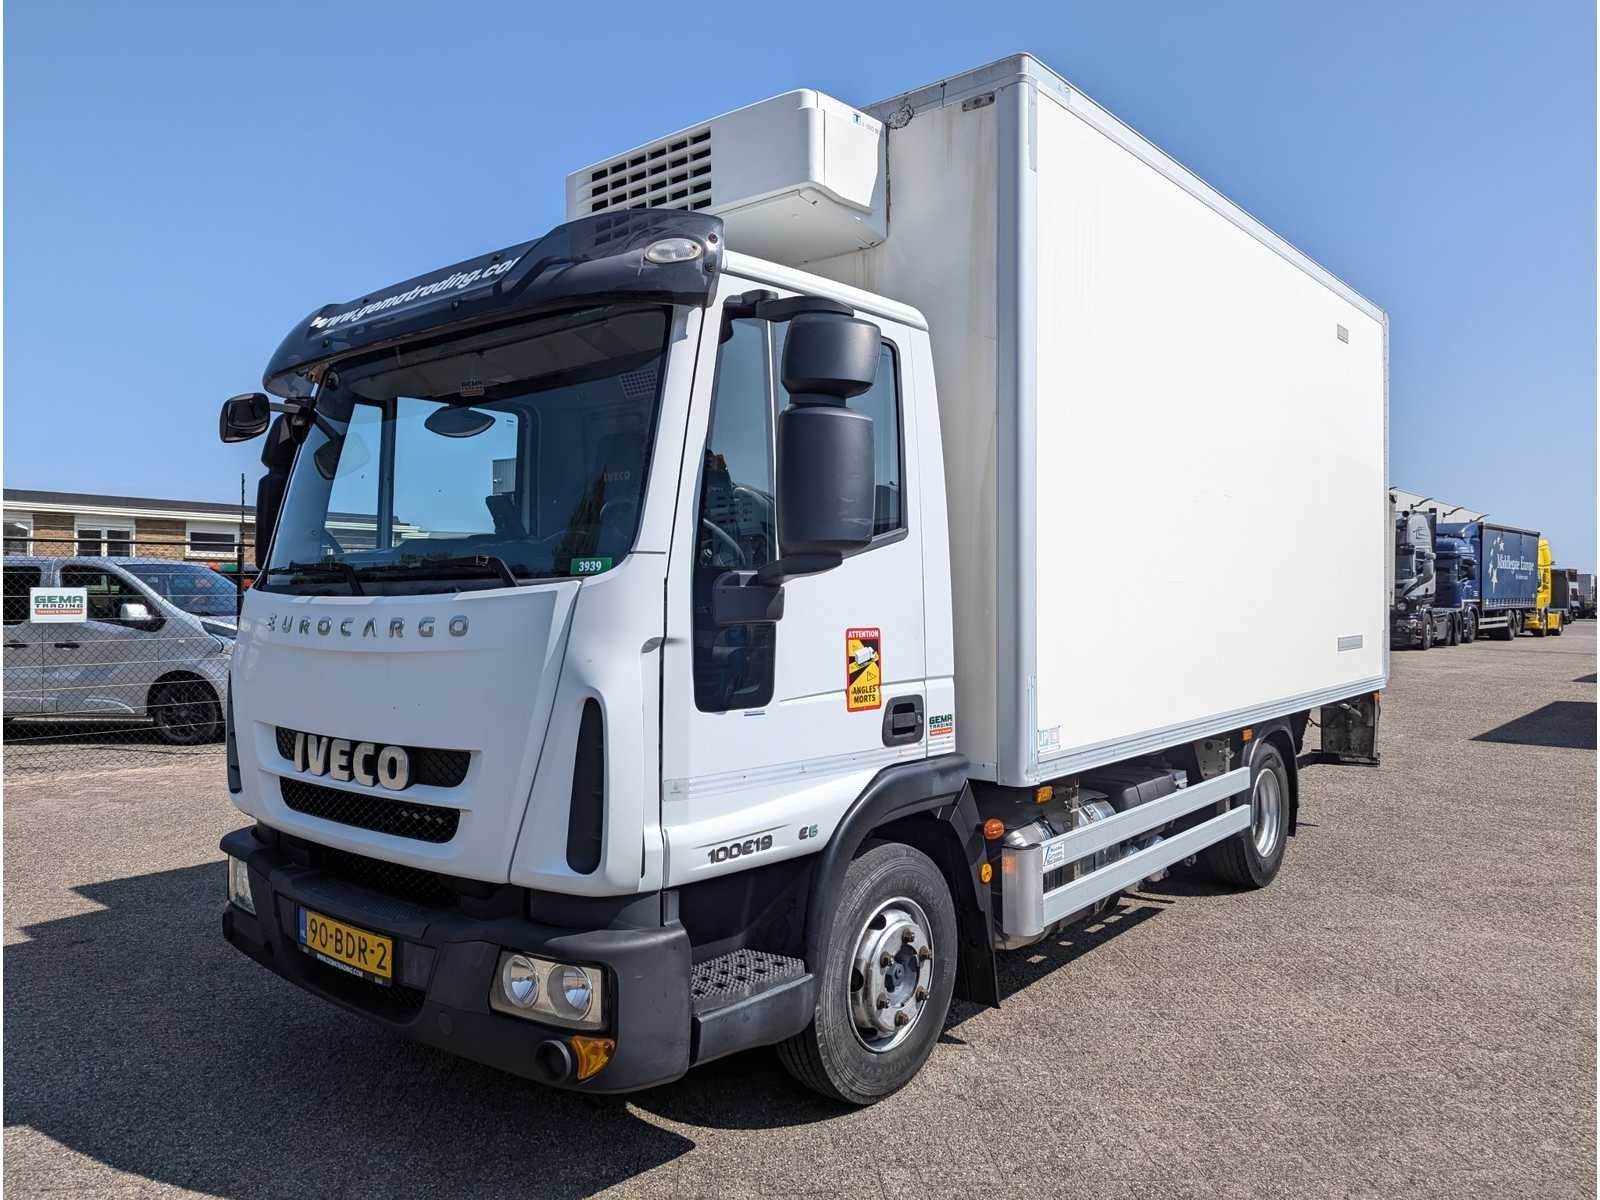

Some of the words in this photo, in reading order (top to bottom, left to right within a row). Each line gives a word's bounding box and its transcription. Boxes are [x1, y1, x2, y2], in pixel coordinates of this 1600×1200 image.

[578, 560, 602, 572] 3939
[34, 595, 83, 604] GEMA
[266, 613, 470, 639] EUROCARGO
[847, 629, 880, 639] ATTENTION
[851, 684, 877, 695] ANGLES
[853, 694, 877, 705] MORTS
[928, 713, 953, 725] GEMA
[294, 732, 410, 792] IVECO
[707, 834, 773, 864] 100E19
[309, 917, 387, 971] 90-BDR-2
